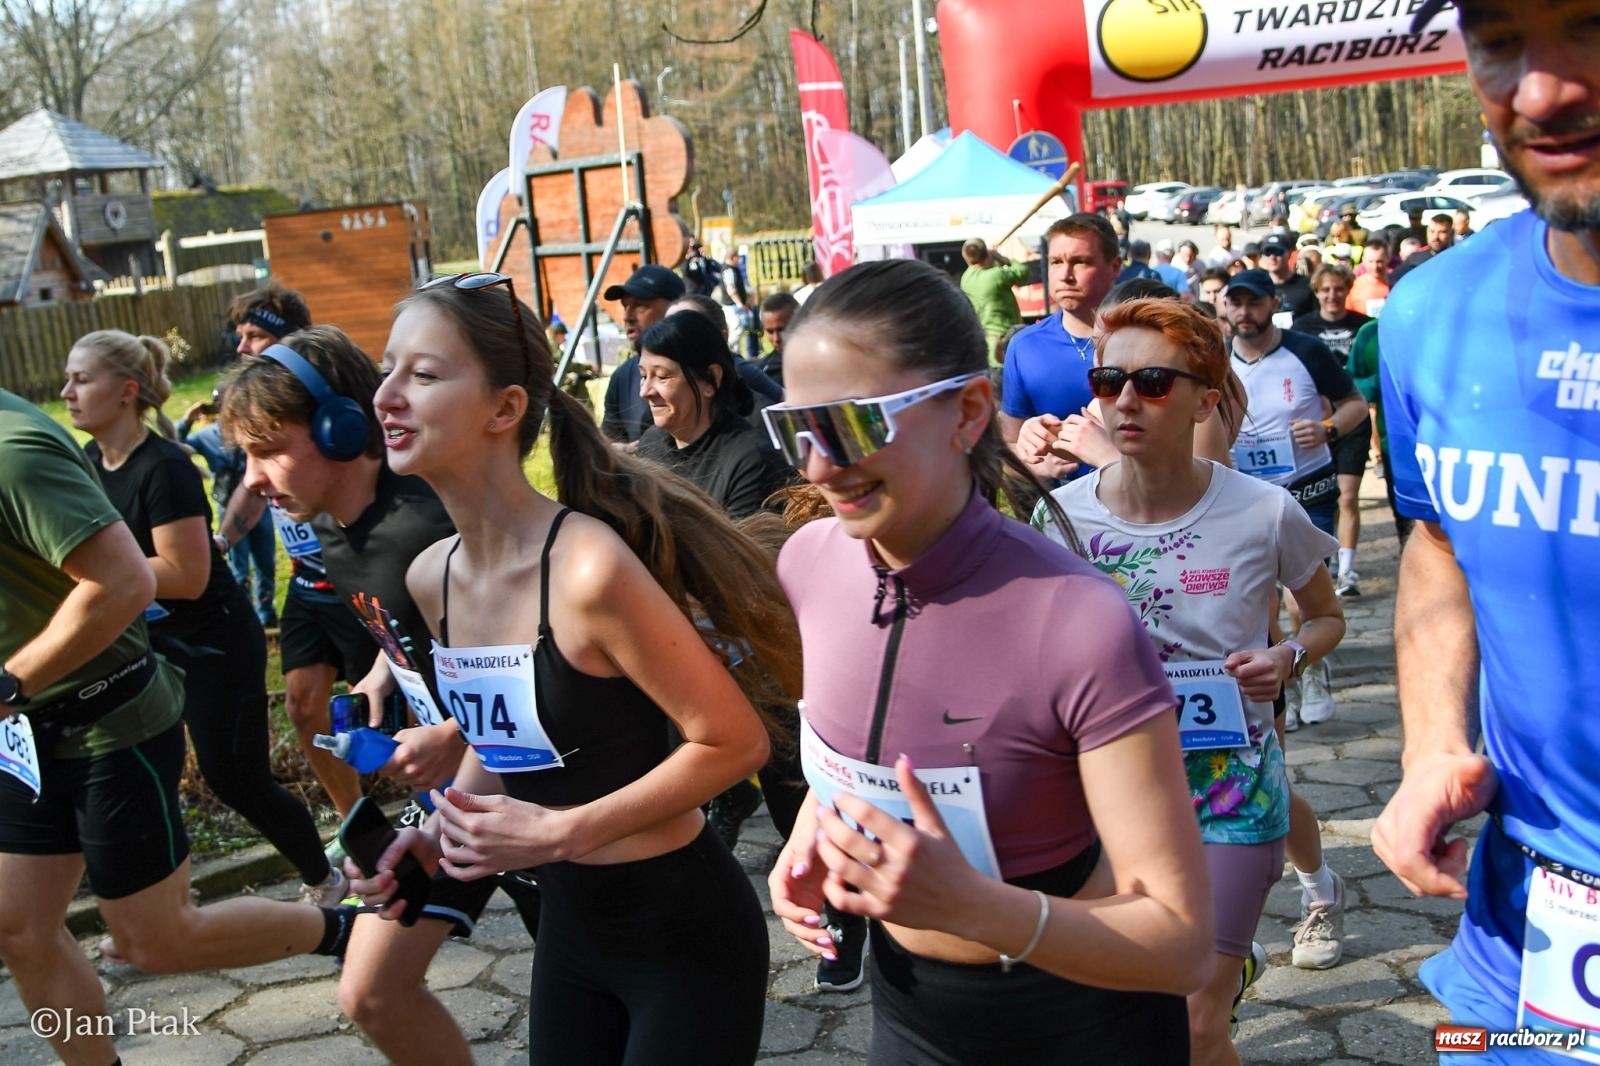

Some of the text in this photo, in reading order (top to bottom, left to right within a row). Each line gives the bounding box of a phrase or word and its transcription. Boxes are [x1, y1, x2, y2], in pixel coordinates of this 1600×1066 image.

[1257, 28, 1447, 71] RACIBÓRZ
[1247, 448, 1278, 467] 131
[281, 523, 310, 544] 116
[1187, 572, 1230, 582] zawsze
[455, 655, 521, 669] TWARDZIELA
[449, 689, 518, 739] 074
[856, 770, 962, 796] TWARELA
